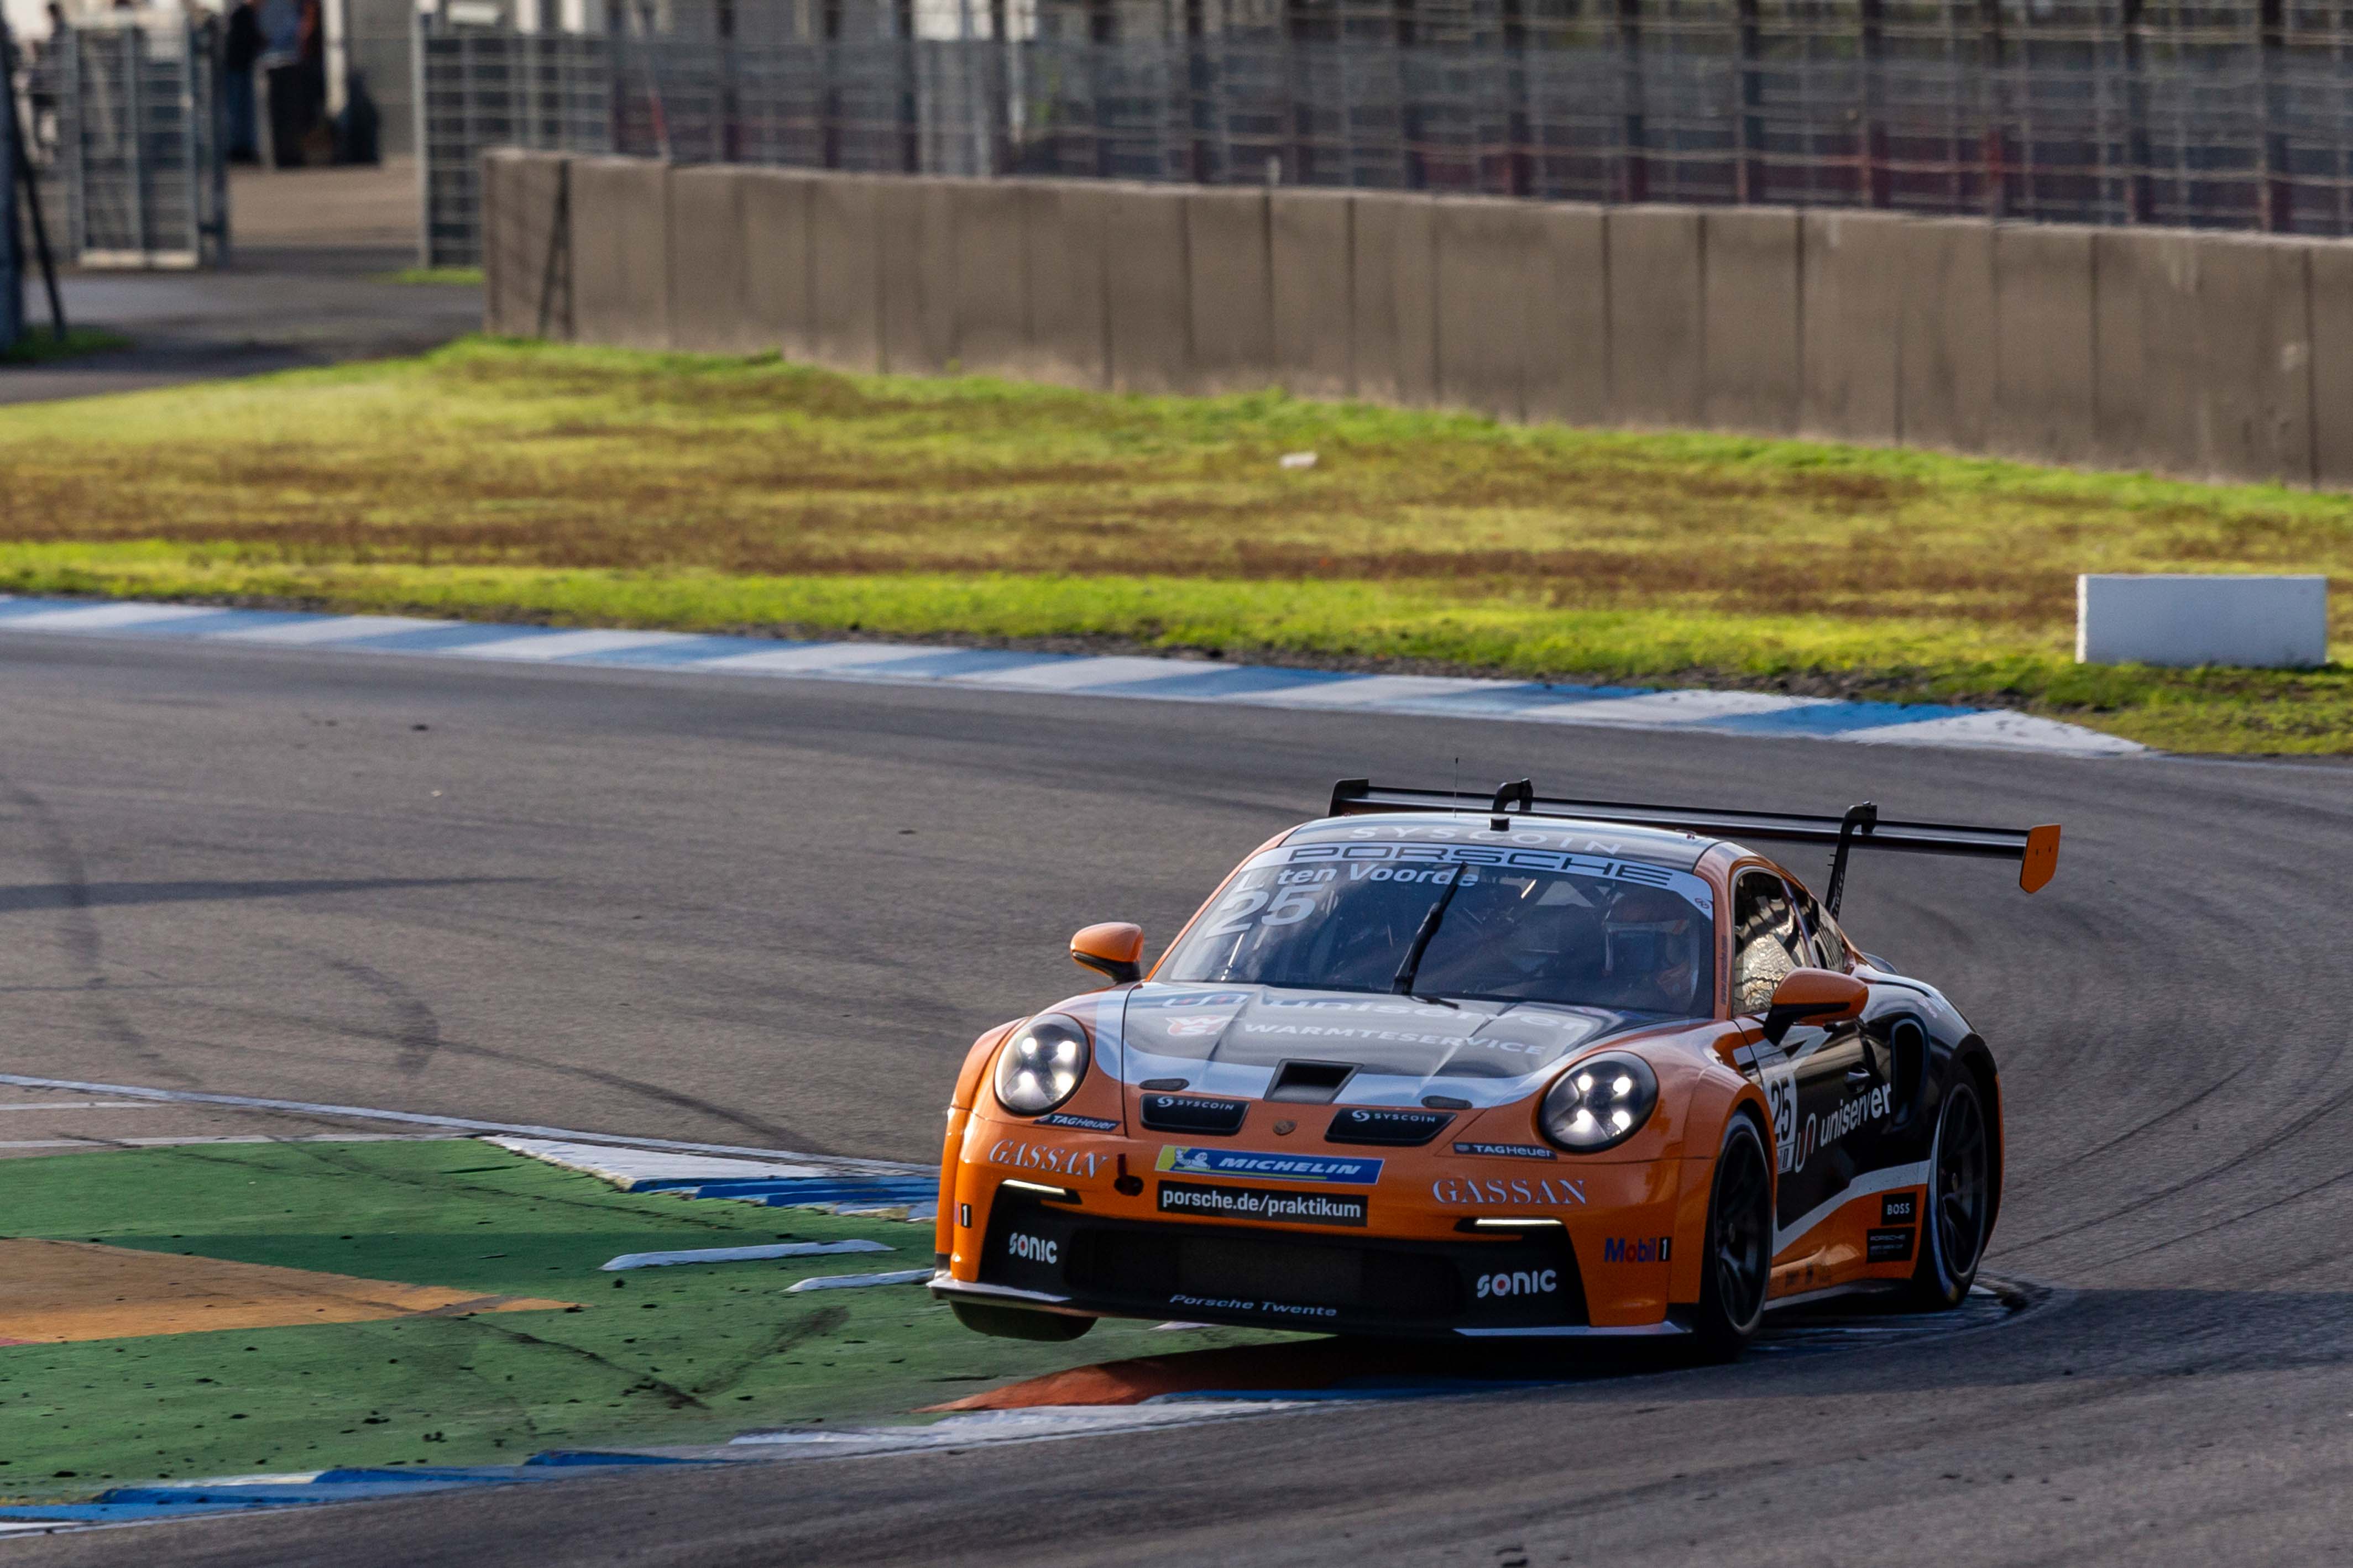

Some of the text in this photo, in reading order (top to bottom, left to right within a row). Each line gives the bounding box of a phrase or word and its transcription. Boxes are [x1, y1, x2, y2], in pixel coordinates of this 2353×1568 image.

[1349, 827, 1622, 855] SYSCOIN
[1278, 869, 1337, 884] ten
[1350, 863, 1479, 887] Voorde
[1288, 847, 1672, 885] PORSCHE
[1204, 884, 1324, 940] 25
[1269, 1001, 1592, 1030] uniserver
[1245, 1024, 1547, 1055] WARMTESERVICE
[1176, 1099, 1235, 1110] SYSCOIN
[1374, 1112, 1435, 1123] SYSCOIN
[1771, 1077, 1792, 1141] 25
[1820, 1083, 1892, 1147] uniserver
[989, 1139, 1107, 1179] GASSAN
[1219, 1157, 1362, 1175] MICHELIN
[1163, 1189, 1361, 1218] porsche.de/praktikum
[1433, 1179, 1587, 1205] GASSAN
[1887, 1203, 1910, 1215] BOSS
[1604, 1237, 1656, 1262] Mobil
[1169, 1294, 1337, 1317] Porsche Twente
